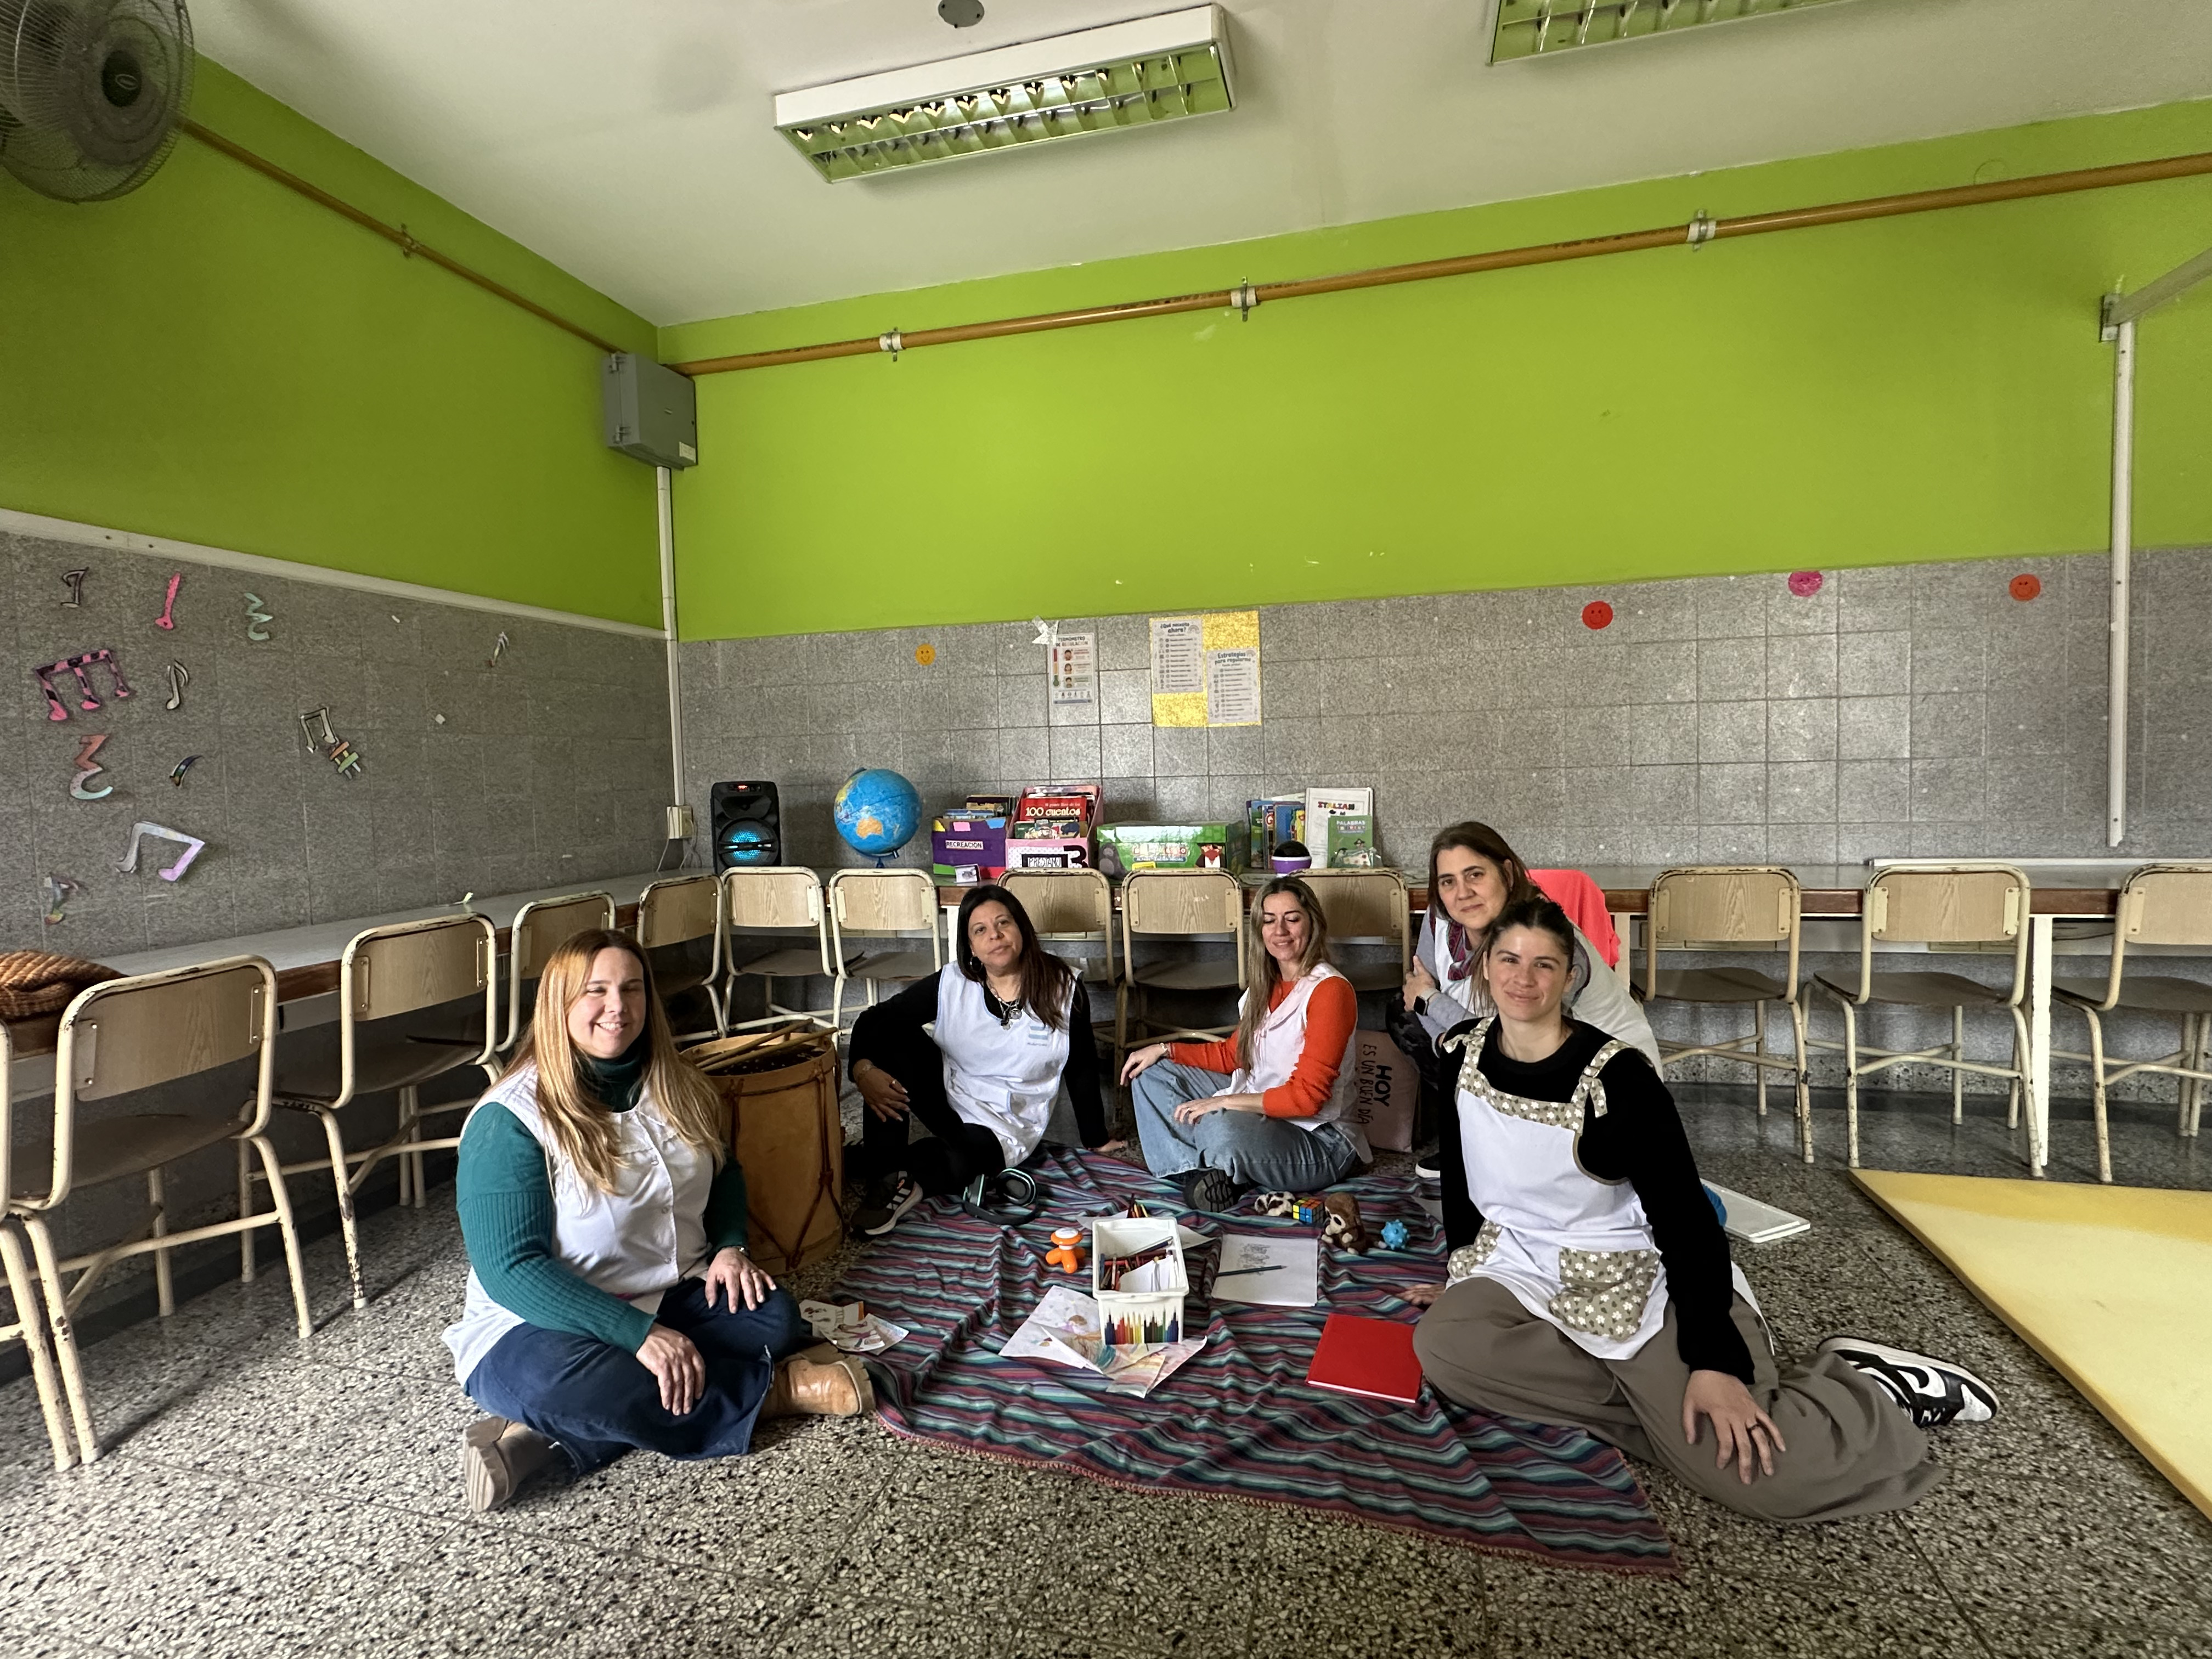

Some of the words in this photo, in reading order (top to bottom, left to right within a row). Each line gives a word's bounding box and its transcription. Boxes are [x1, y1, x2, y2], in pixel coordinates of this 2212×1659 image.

[1025, 806, 1044, 816] 100
[1045, 806, 1081, 816] cuentos
[1363, 1043, 1377, 1057] ES
[1361, 1060, 1376, 1075] UN
[1359, 1078, 1374, 1105] BUEN
[1374, 1064, 1392, 1107] HOY
[1357, 1109, 1374, 1125] DÍA
